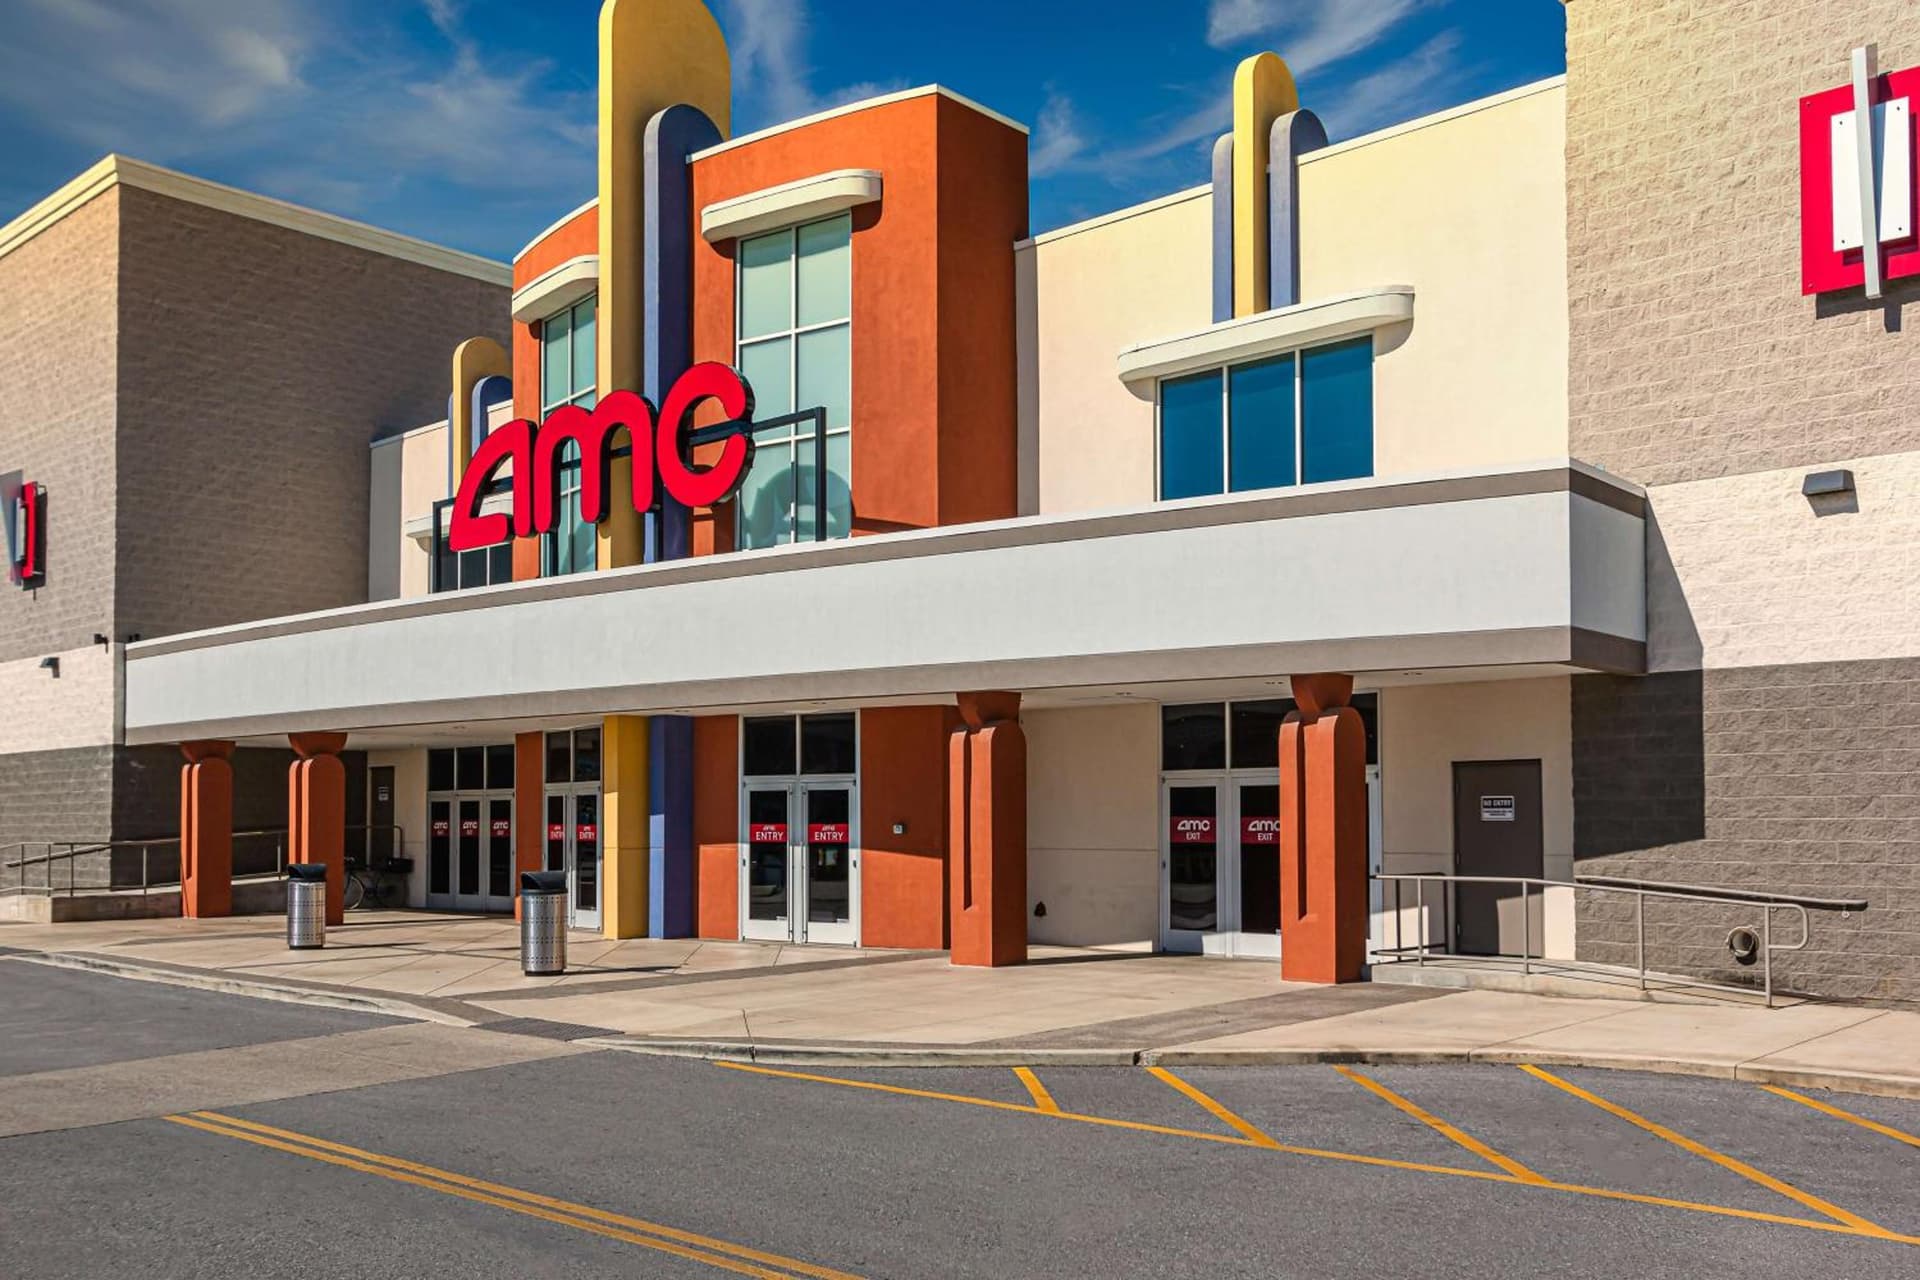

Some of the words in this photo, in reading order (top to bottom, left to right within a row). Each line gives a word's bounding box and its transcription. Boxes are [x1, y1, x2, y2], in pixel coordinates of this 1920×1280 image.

[755, 831, 784, 841] ENTRY
[814, 831, 844, 841] ENTRY
[1186, 832, 1201, 840] EXIT
[1257, 833, 1273, 841] EXIT
